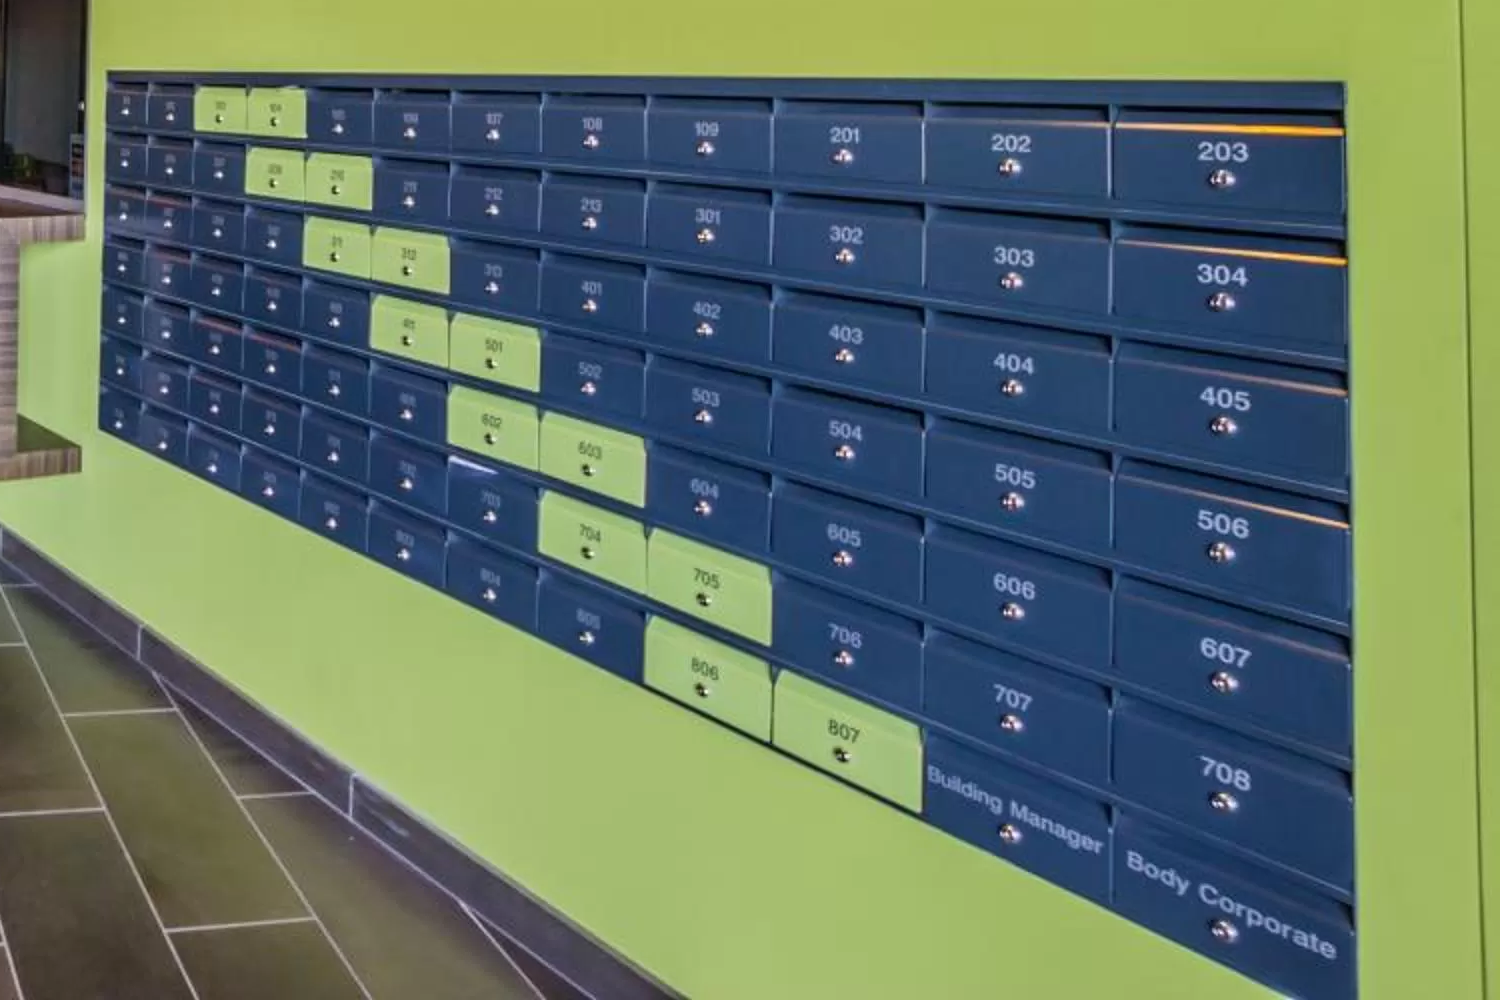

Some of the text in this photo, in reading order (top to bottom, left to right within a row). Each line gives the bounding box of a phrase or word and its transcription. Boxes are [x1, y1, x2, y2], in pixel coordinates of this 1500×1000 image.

[485, 112, 504, 125] 107
[582, 118, 603, 131] 108
[695, 121, 719, 137] 109
[830, 127, 859, 144] 201
[991, 134, 1031, 153] 202
[1198, 141, 1249, 163] 203
[484, 188, 503, 201] 212
[580, 197, 603, 213] 213
[696, 209, 721, 226] 301
[829, 226, 863, 245] 302
[993, 246, 1035, 267] 303
[1197, 265, 1248, 287] 304
[581, 281, 603, 296] 401
[693, 301, 721, 320] 402
[485, 338, 504, 353] 501
[828, 324, 864, 345] 403
[578, 361, 603, 379] 502
[993, 353, 1035, 375] 404
[692, 387, 720, 409] 503
[1200, 387, 1251, 411] 405
[481, 413, 503, 429] 602
[829, 420, 862, 442] 504
[578, 440, 603, 459] 603
[994, 464, 1036, 489] 505
[690, 477, 719, 500] 604
[579, 523, 601, 543] 704
[827, 523, 861, 547] 605
[1197, 510, 1250, 540] 506
[693, 567, 721, 590] 705
[993, 573, 1035, 600] 606
[828, 624, 862, 649] 706
[1200, 637, 1252, 669] 607
[690, 656, 719, 681] 806
[993, 684, 1032, 713] 707
[828, 719, 860, 744] 807
[1200, 757, 1252, 791] 708
[927, 765, 1104, 855] Building Manager
[1126, 850, 1338, 961] Body Corporate
